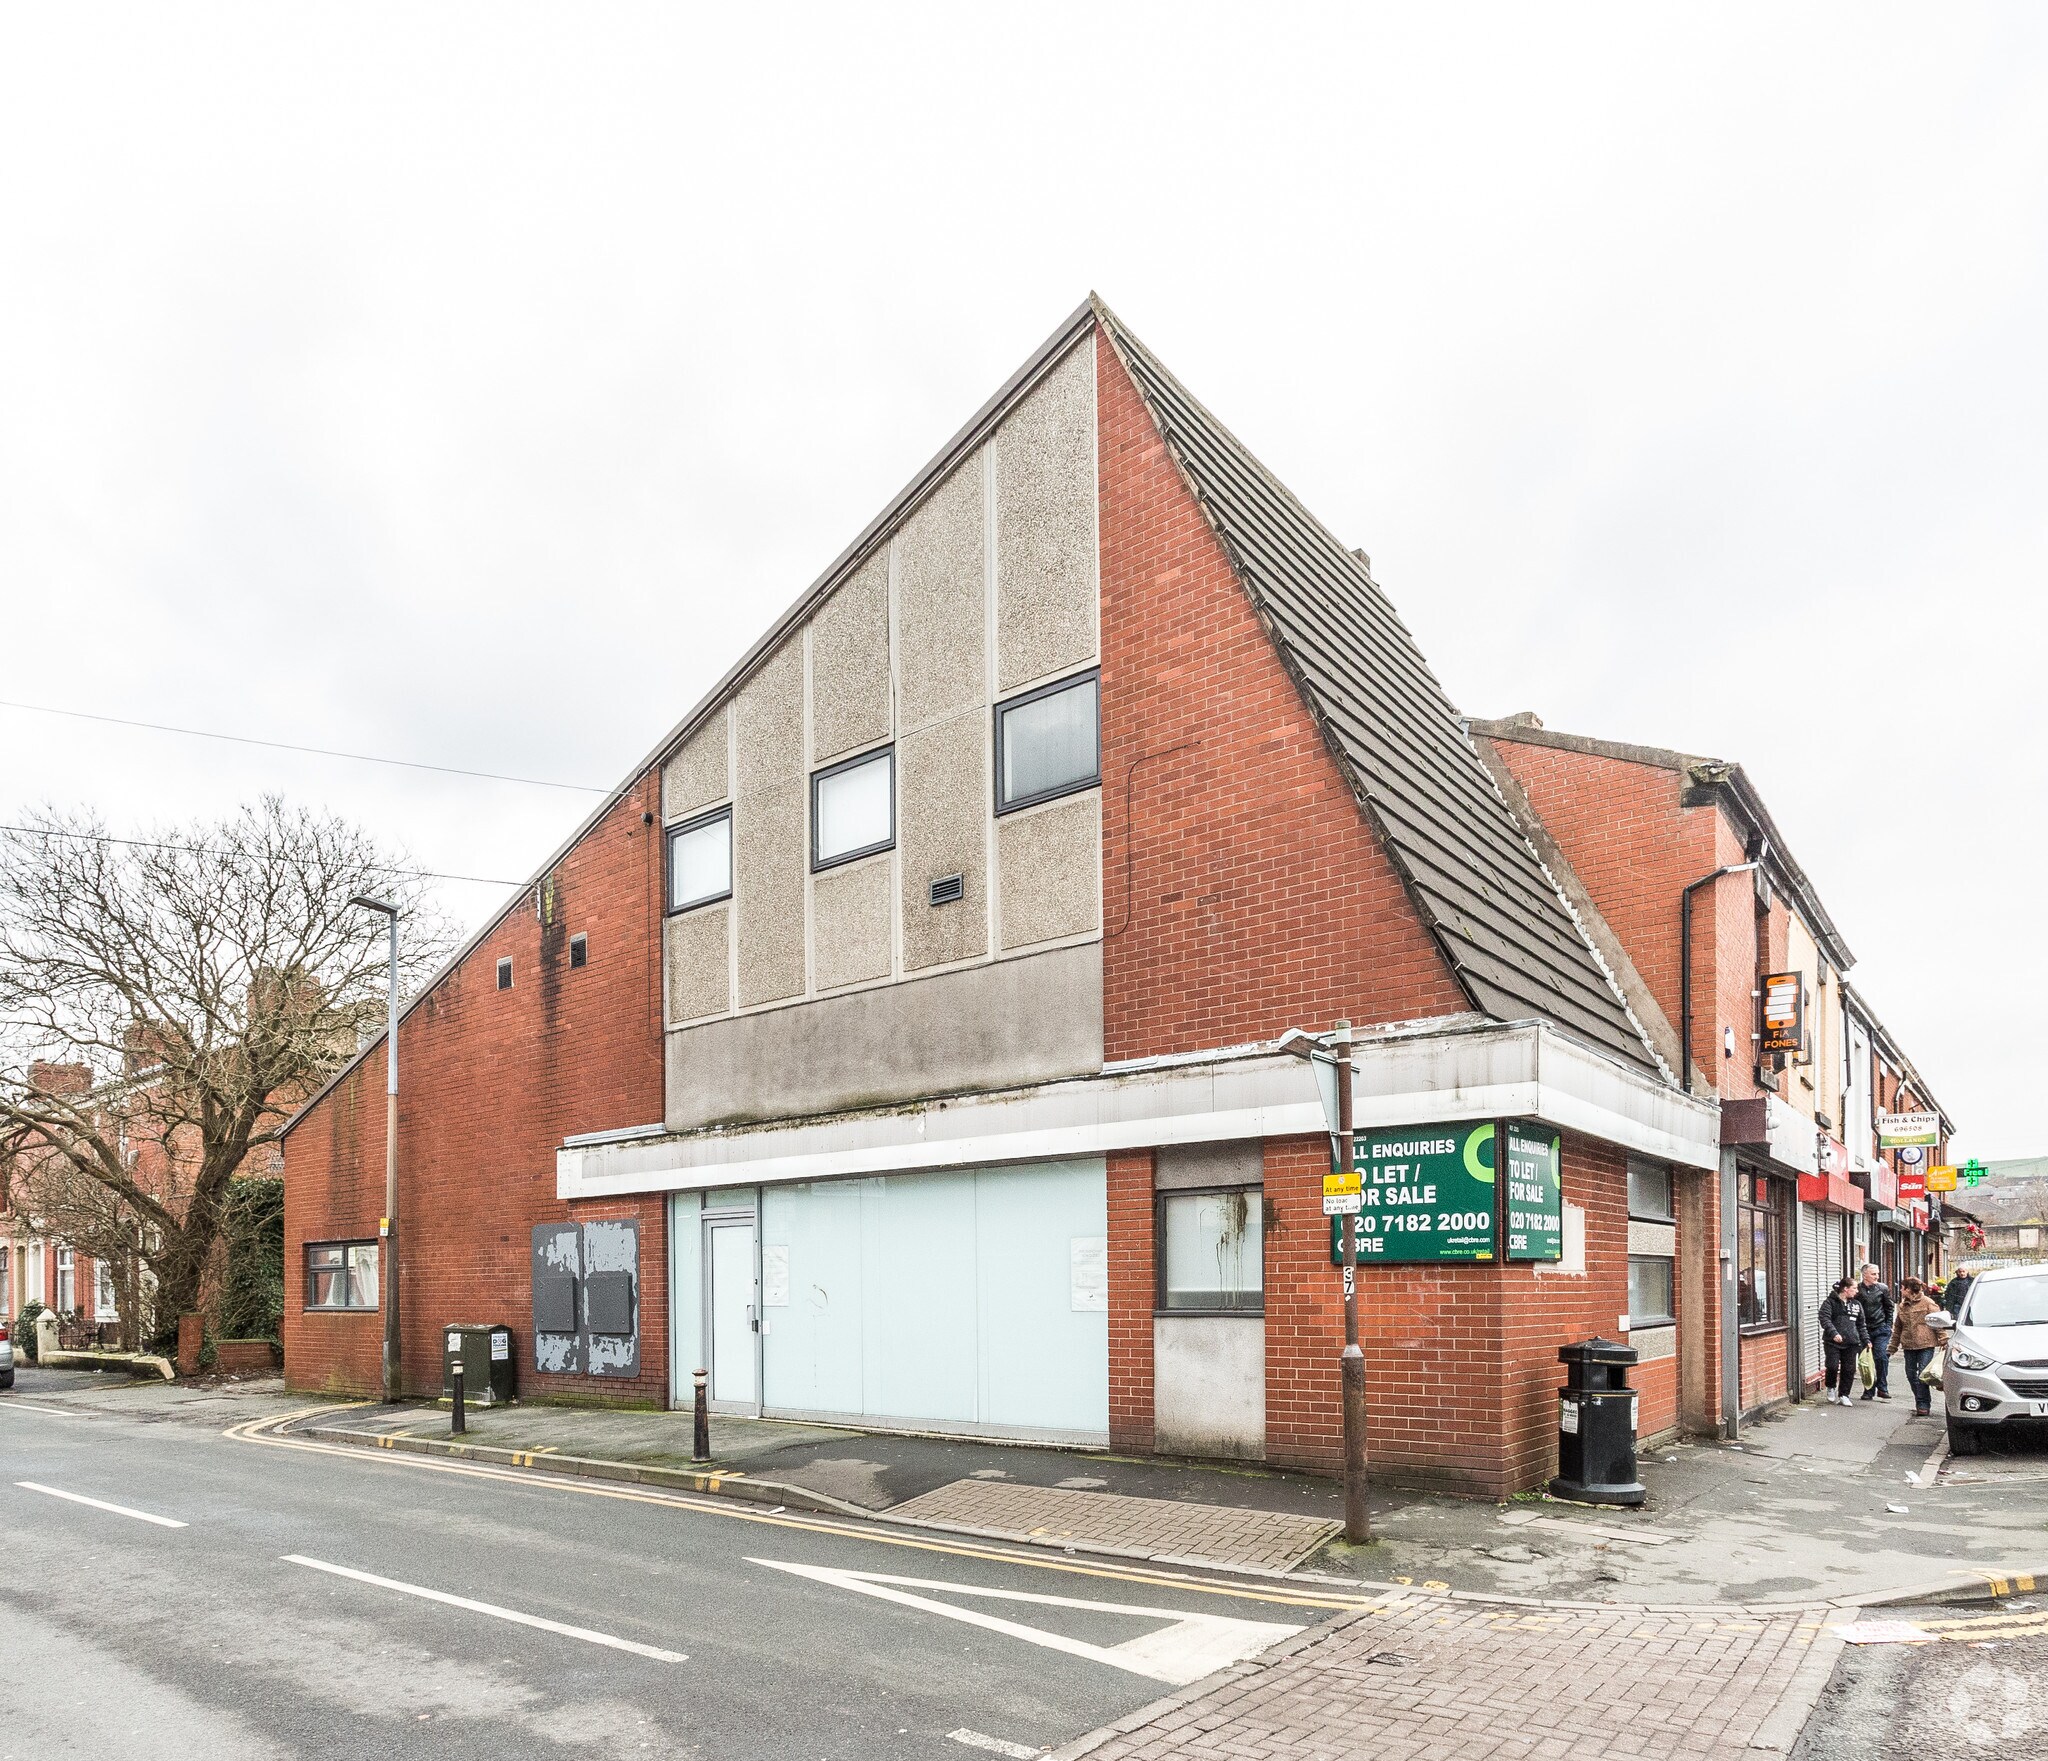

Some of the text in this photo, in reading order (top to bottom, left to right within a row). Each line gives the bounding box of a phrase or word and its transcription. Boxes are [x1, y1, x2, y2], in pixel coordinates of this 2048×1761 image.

[1765, 1039, 1798, 1049] FONES
[1353, 1139, 1455, 1159] LL ENQUIRIES
[1509, 1136, 1548, 1156] ALL ENQUIRIES
[1373, 1165, 1409, 1184] LET
[1509, 1160, 1520, 1178] TO
[1521, 1161, 1534, 1180] LET
[1385, 1185, 1436, 1205] SALE
[1509, 1181, 1543, 1203] FOR SALE
[1341, 1212, 1490, 1233] 20 7182 2000
[1510, 1211, 1560, 1232] 020 7182 2000
[1509, 1235, 1527, 1249] CBRE
[2038, 1402, 2048, 1414] V
